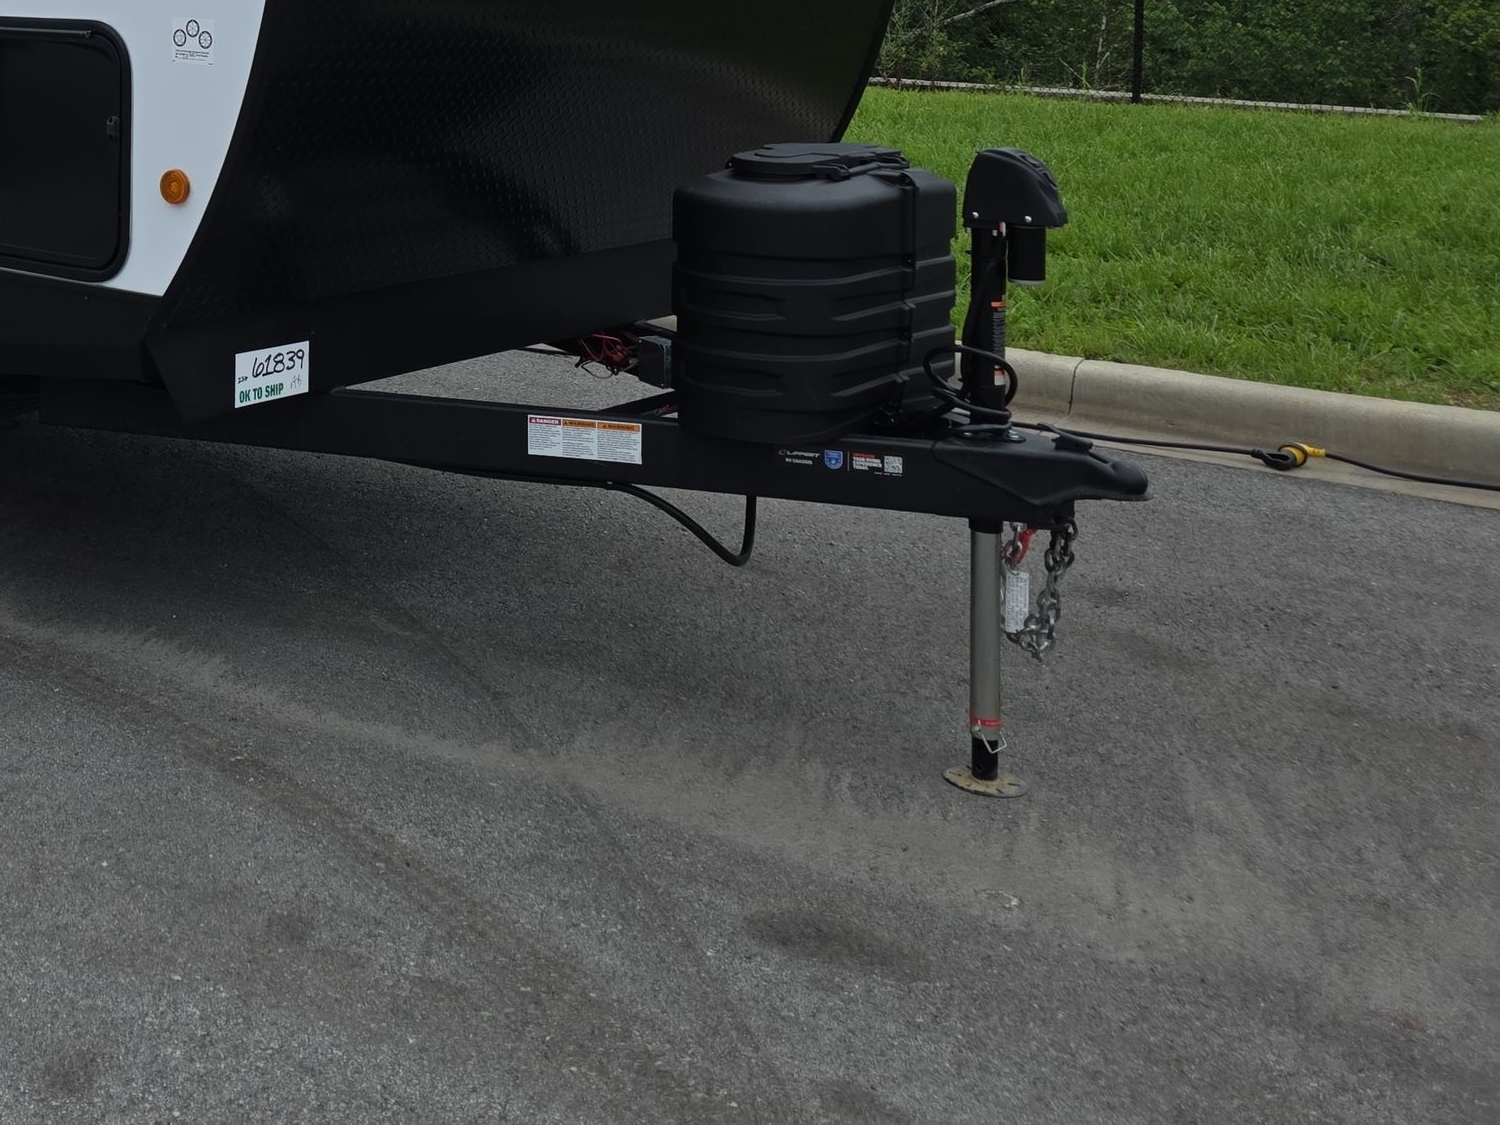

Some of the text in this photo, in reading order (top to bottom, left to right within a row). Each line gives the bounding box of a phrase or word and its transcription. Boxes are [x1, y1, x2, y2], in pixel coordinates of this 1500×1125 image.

[252, 349, 305, 378] 61839
[239, 382, 284, 403] OK TO SHIP
